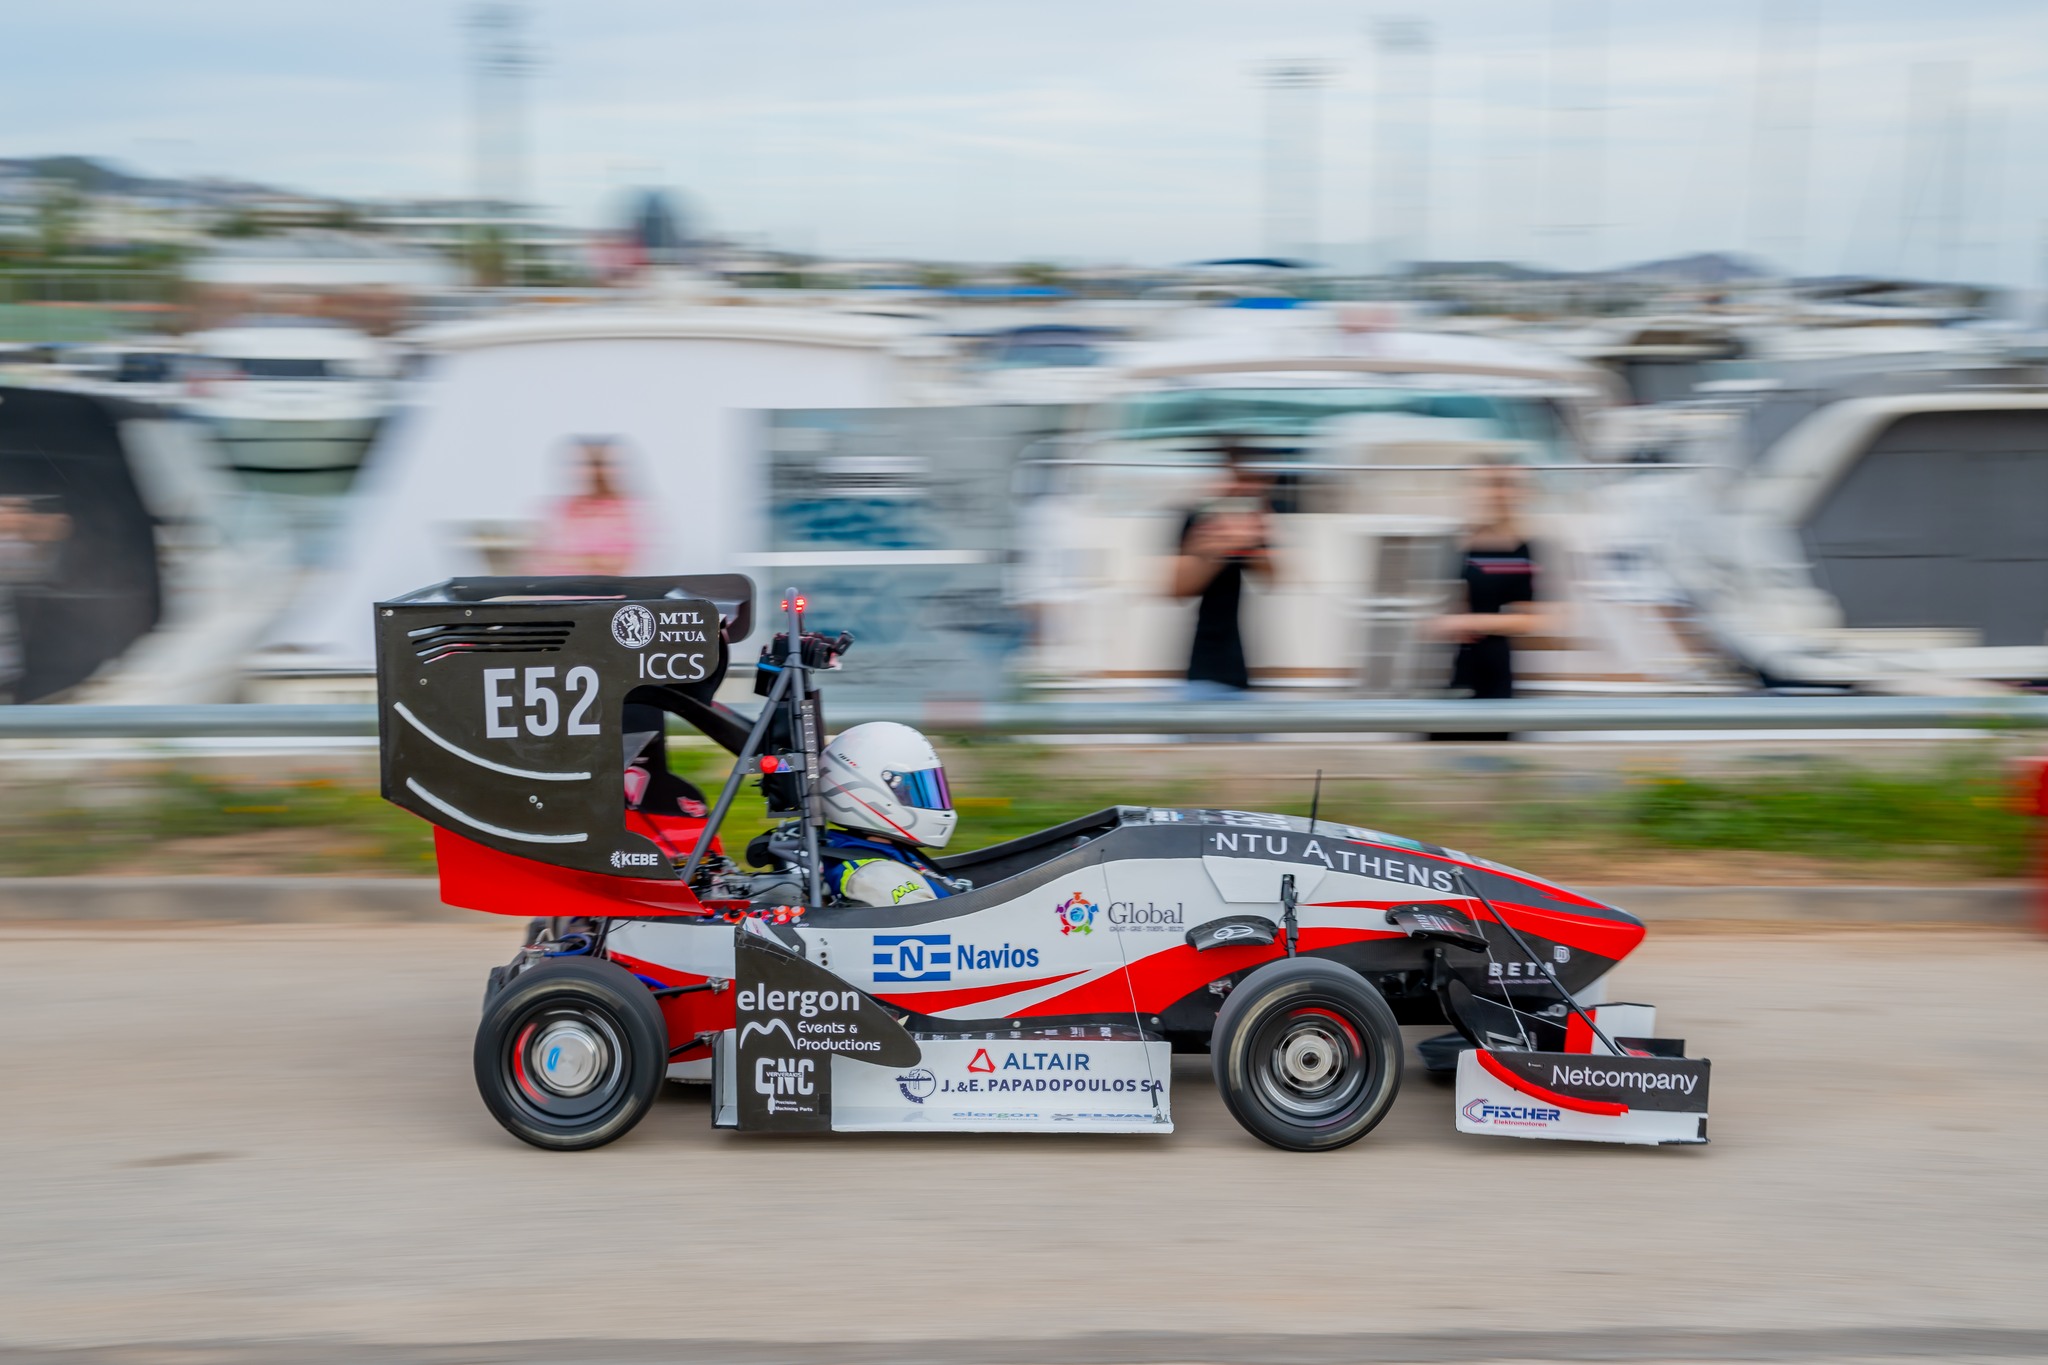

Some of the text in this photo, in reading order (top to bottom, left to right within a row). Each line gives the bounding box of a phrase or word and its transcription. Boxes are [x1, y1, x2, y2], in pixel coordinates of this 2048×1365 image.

[659, 612, 704, 625] MTL
[659, 630, 707, 642] NTUA
[639, 652, 705, 680] ICCS
[483, 665, 601, 739] E52
[621, 853, 659, 866] KEBE
[1216, 832, 1454, 892] NTU ATHENS
[1108, 901, 1184, 925] Global
[899, 945, 924, 971] N
[957, 943, 1039, 970] Navios
[1488, 961, 1557, 977] BETA
[736, 983, 860, 1018] elergon
[797, 1021, 858, 1034] Events &
[797, 1038, 881, 1051] Productions
[1002, 1052, 1090, 1071] ALTAIR
[988, 1078, 1137, 1092] PAPADOPOULOS
[1140, 1079, 1164, 1093] SA
[1552, 1064, 1699, 1095] Netcompany
[1482, 1105, 1561, 1122] FISCHER
[1493, 1119, 1548, 1127] Elektromotoren
